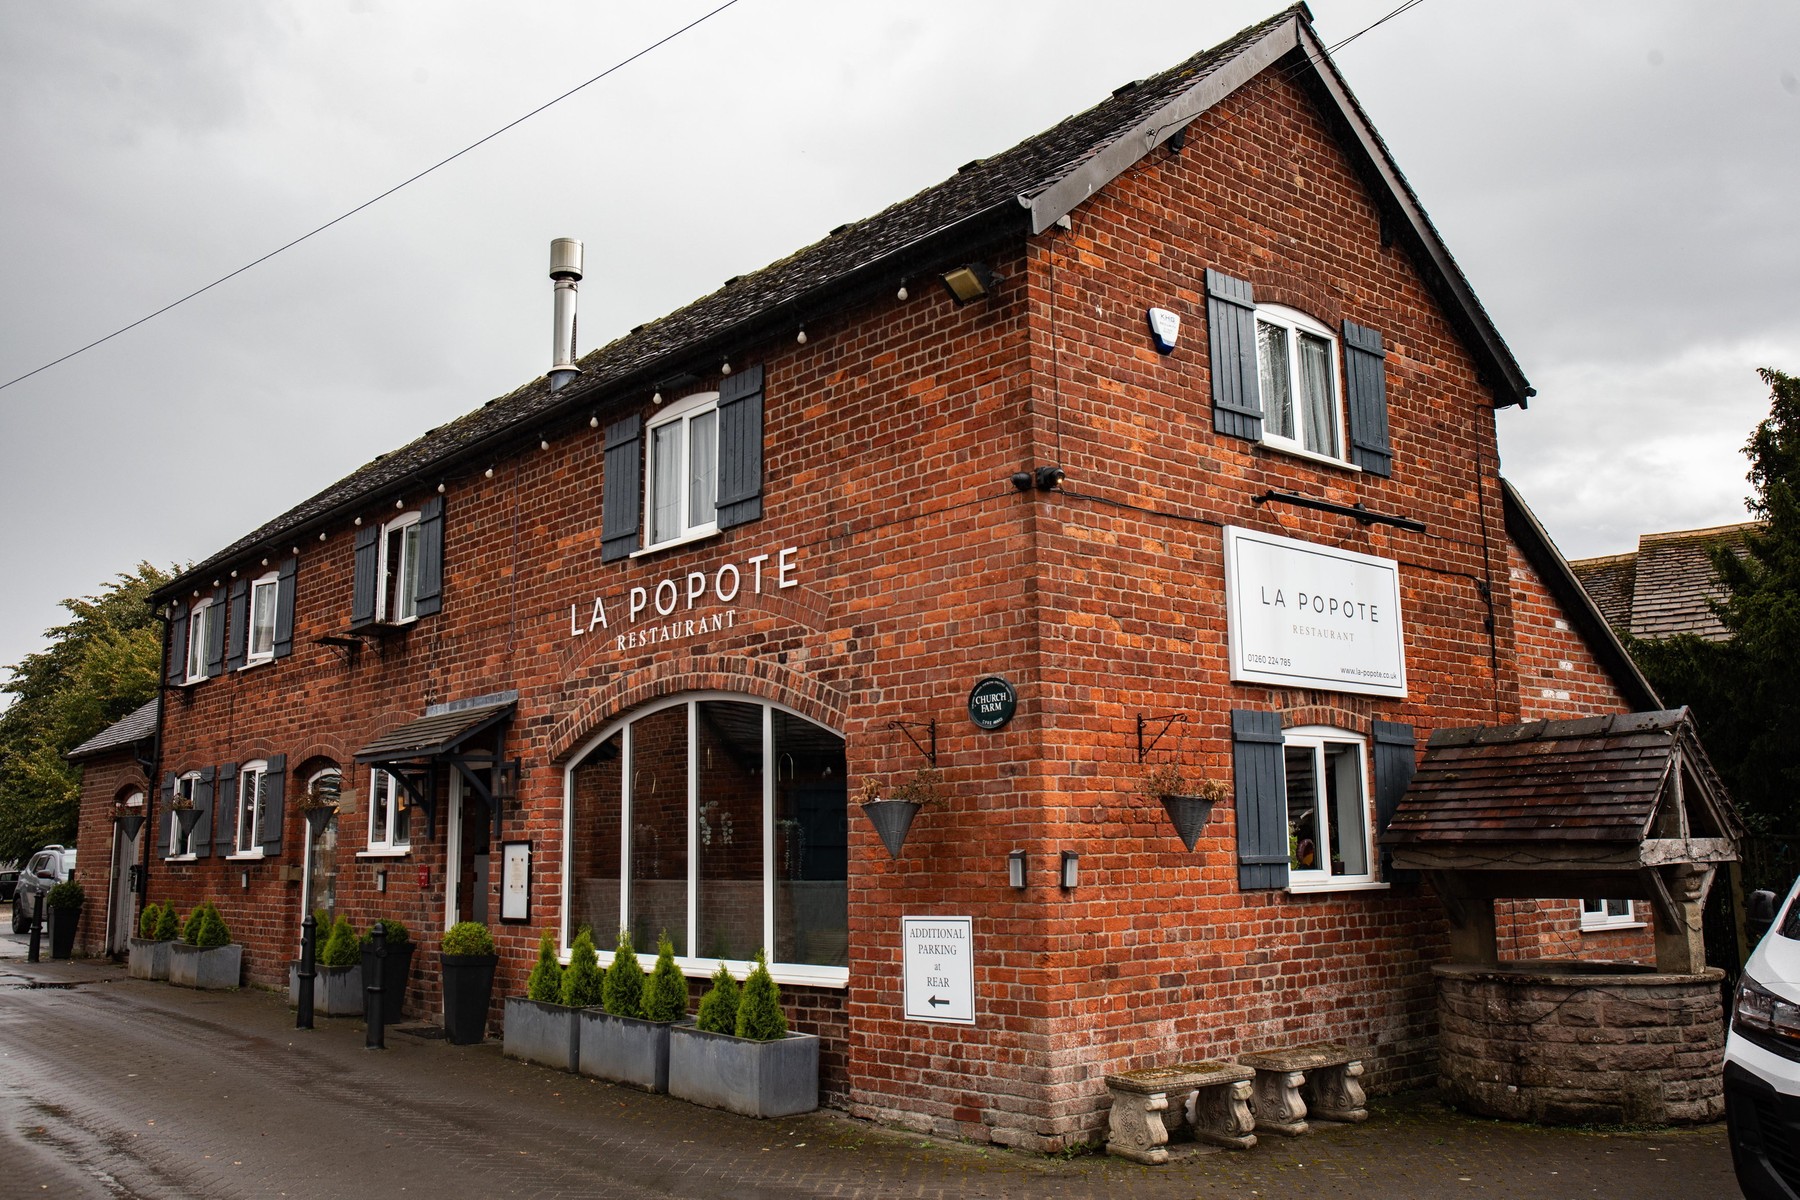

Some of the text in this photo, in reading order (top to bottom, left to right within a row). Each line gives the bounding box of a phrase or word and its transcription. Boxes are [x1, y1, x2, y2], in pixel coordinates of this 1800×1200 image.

[571, 546, 798, 636] LA POPOTE
[1261, 586, 1378, 622] LA POPOTE
[617, 609, 736, 651] RESTAURANT
[1293, 624, 1354, 642] RESTAURANT
[1247, 653, 1291, 667] 01260 224 785
[1341, 667, 1397, 679] www.la-popote.co.uk
[975, 692, 1007, 705] CHURCH
[981, 702, 1002, 713] FARM
[909, 928, 965, 939] ADDITIONAL
[918, 944, 957, 955] PARKING
[934, 963, 941, 971] at
[927, 976, 950, 988] REAR
